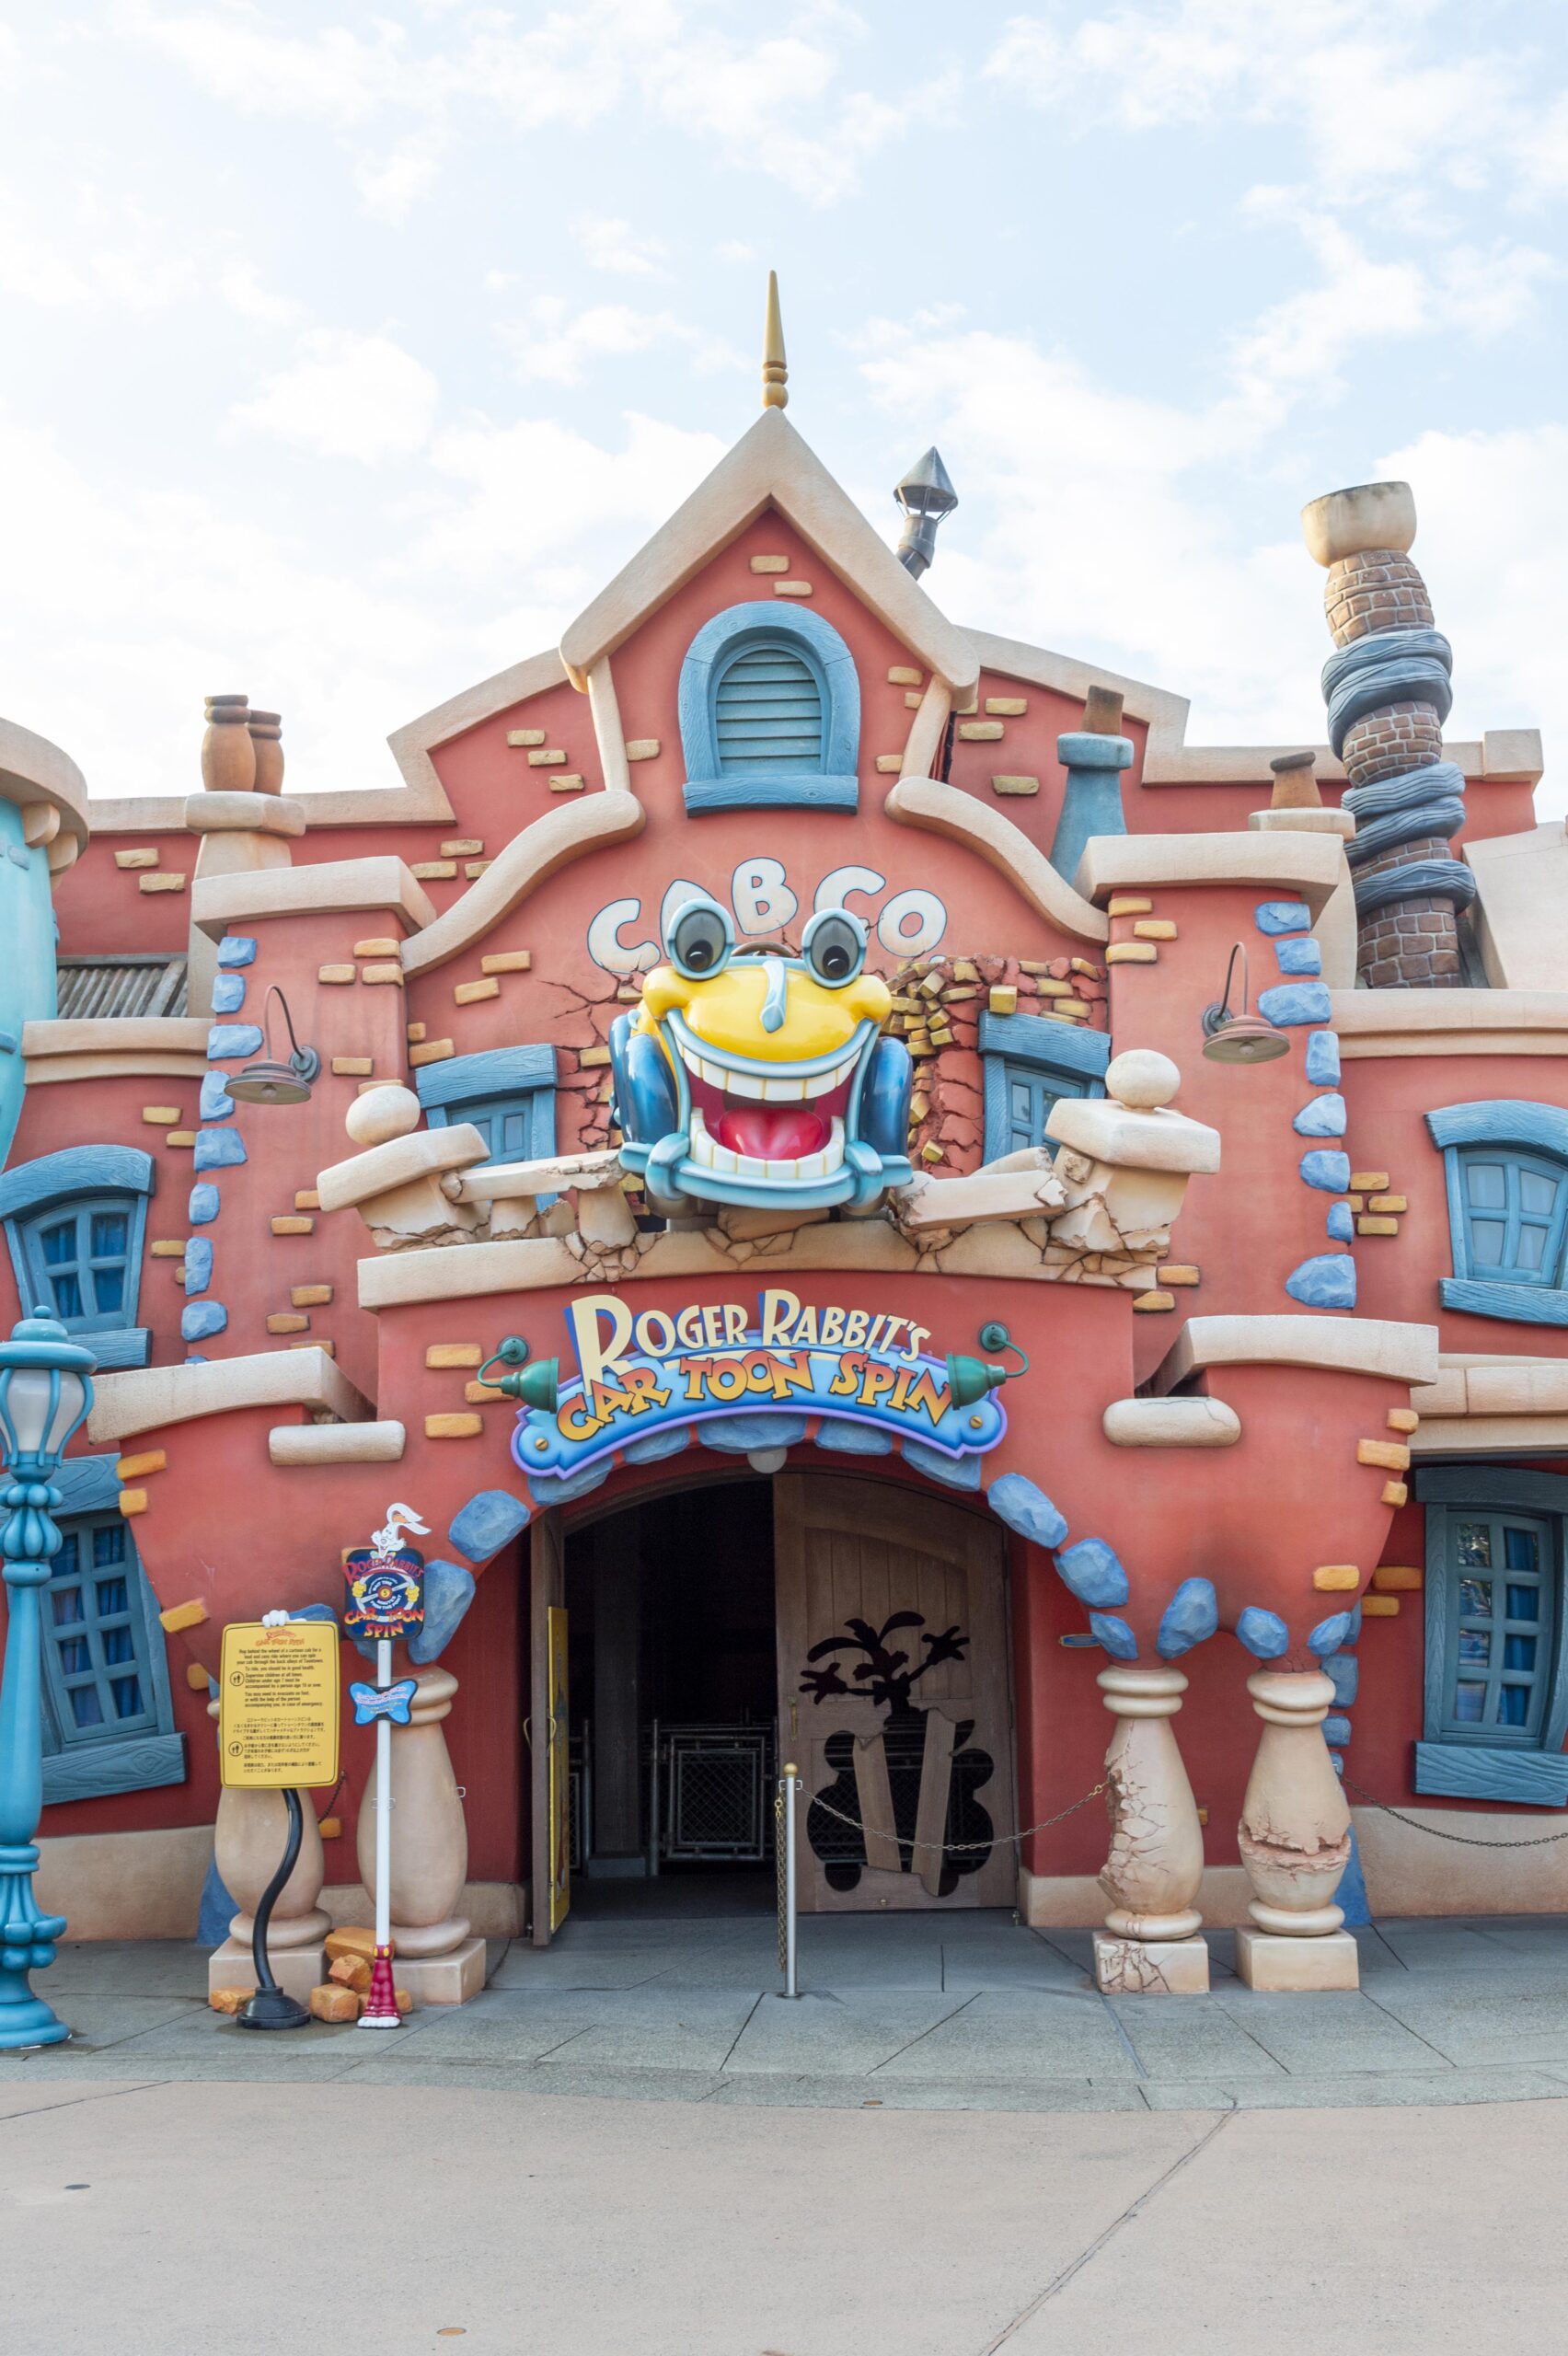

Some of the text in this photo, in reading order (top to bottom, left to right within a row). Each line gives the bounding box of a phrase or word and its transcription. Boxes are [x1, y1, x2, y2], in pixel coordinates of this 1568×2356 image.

[564, 1288, 931, 1397] ROGER RABBIT'S
[557, 1349, 952, 1441] CAR TOON SPIN
[344, 1607, 425, 1624] CAR TOON
[363, 1622, 404, 1638] SPIN
